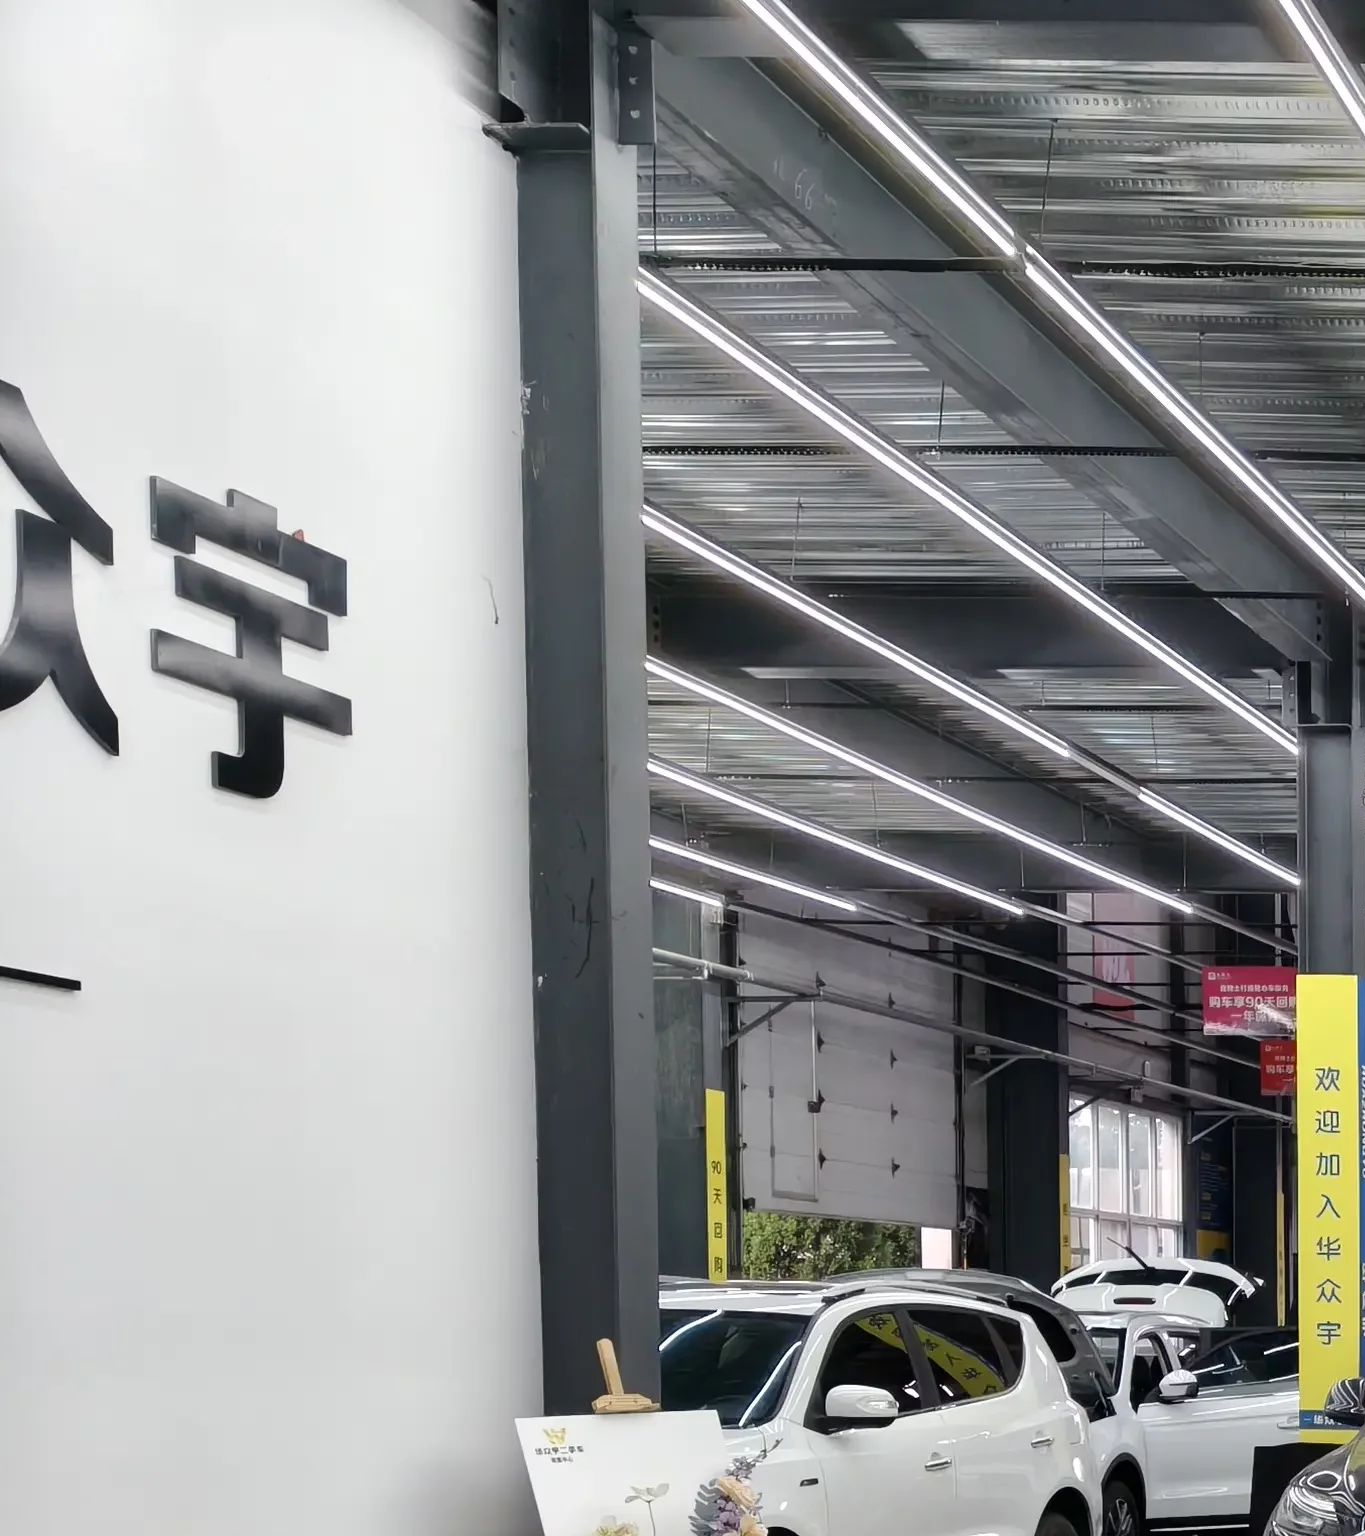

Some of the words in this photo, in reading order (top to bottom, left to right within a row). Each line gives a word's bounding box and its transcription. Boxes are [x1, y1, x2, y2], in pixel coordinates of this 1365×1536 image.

[710, 1160, 724, 1274] 90天回购
[1314, 1066, 1342, 1346] 欢迎加入华众宇
